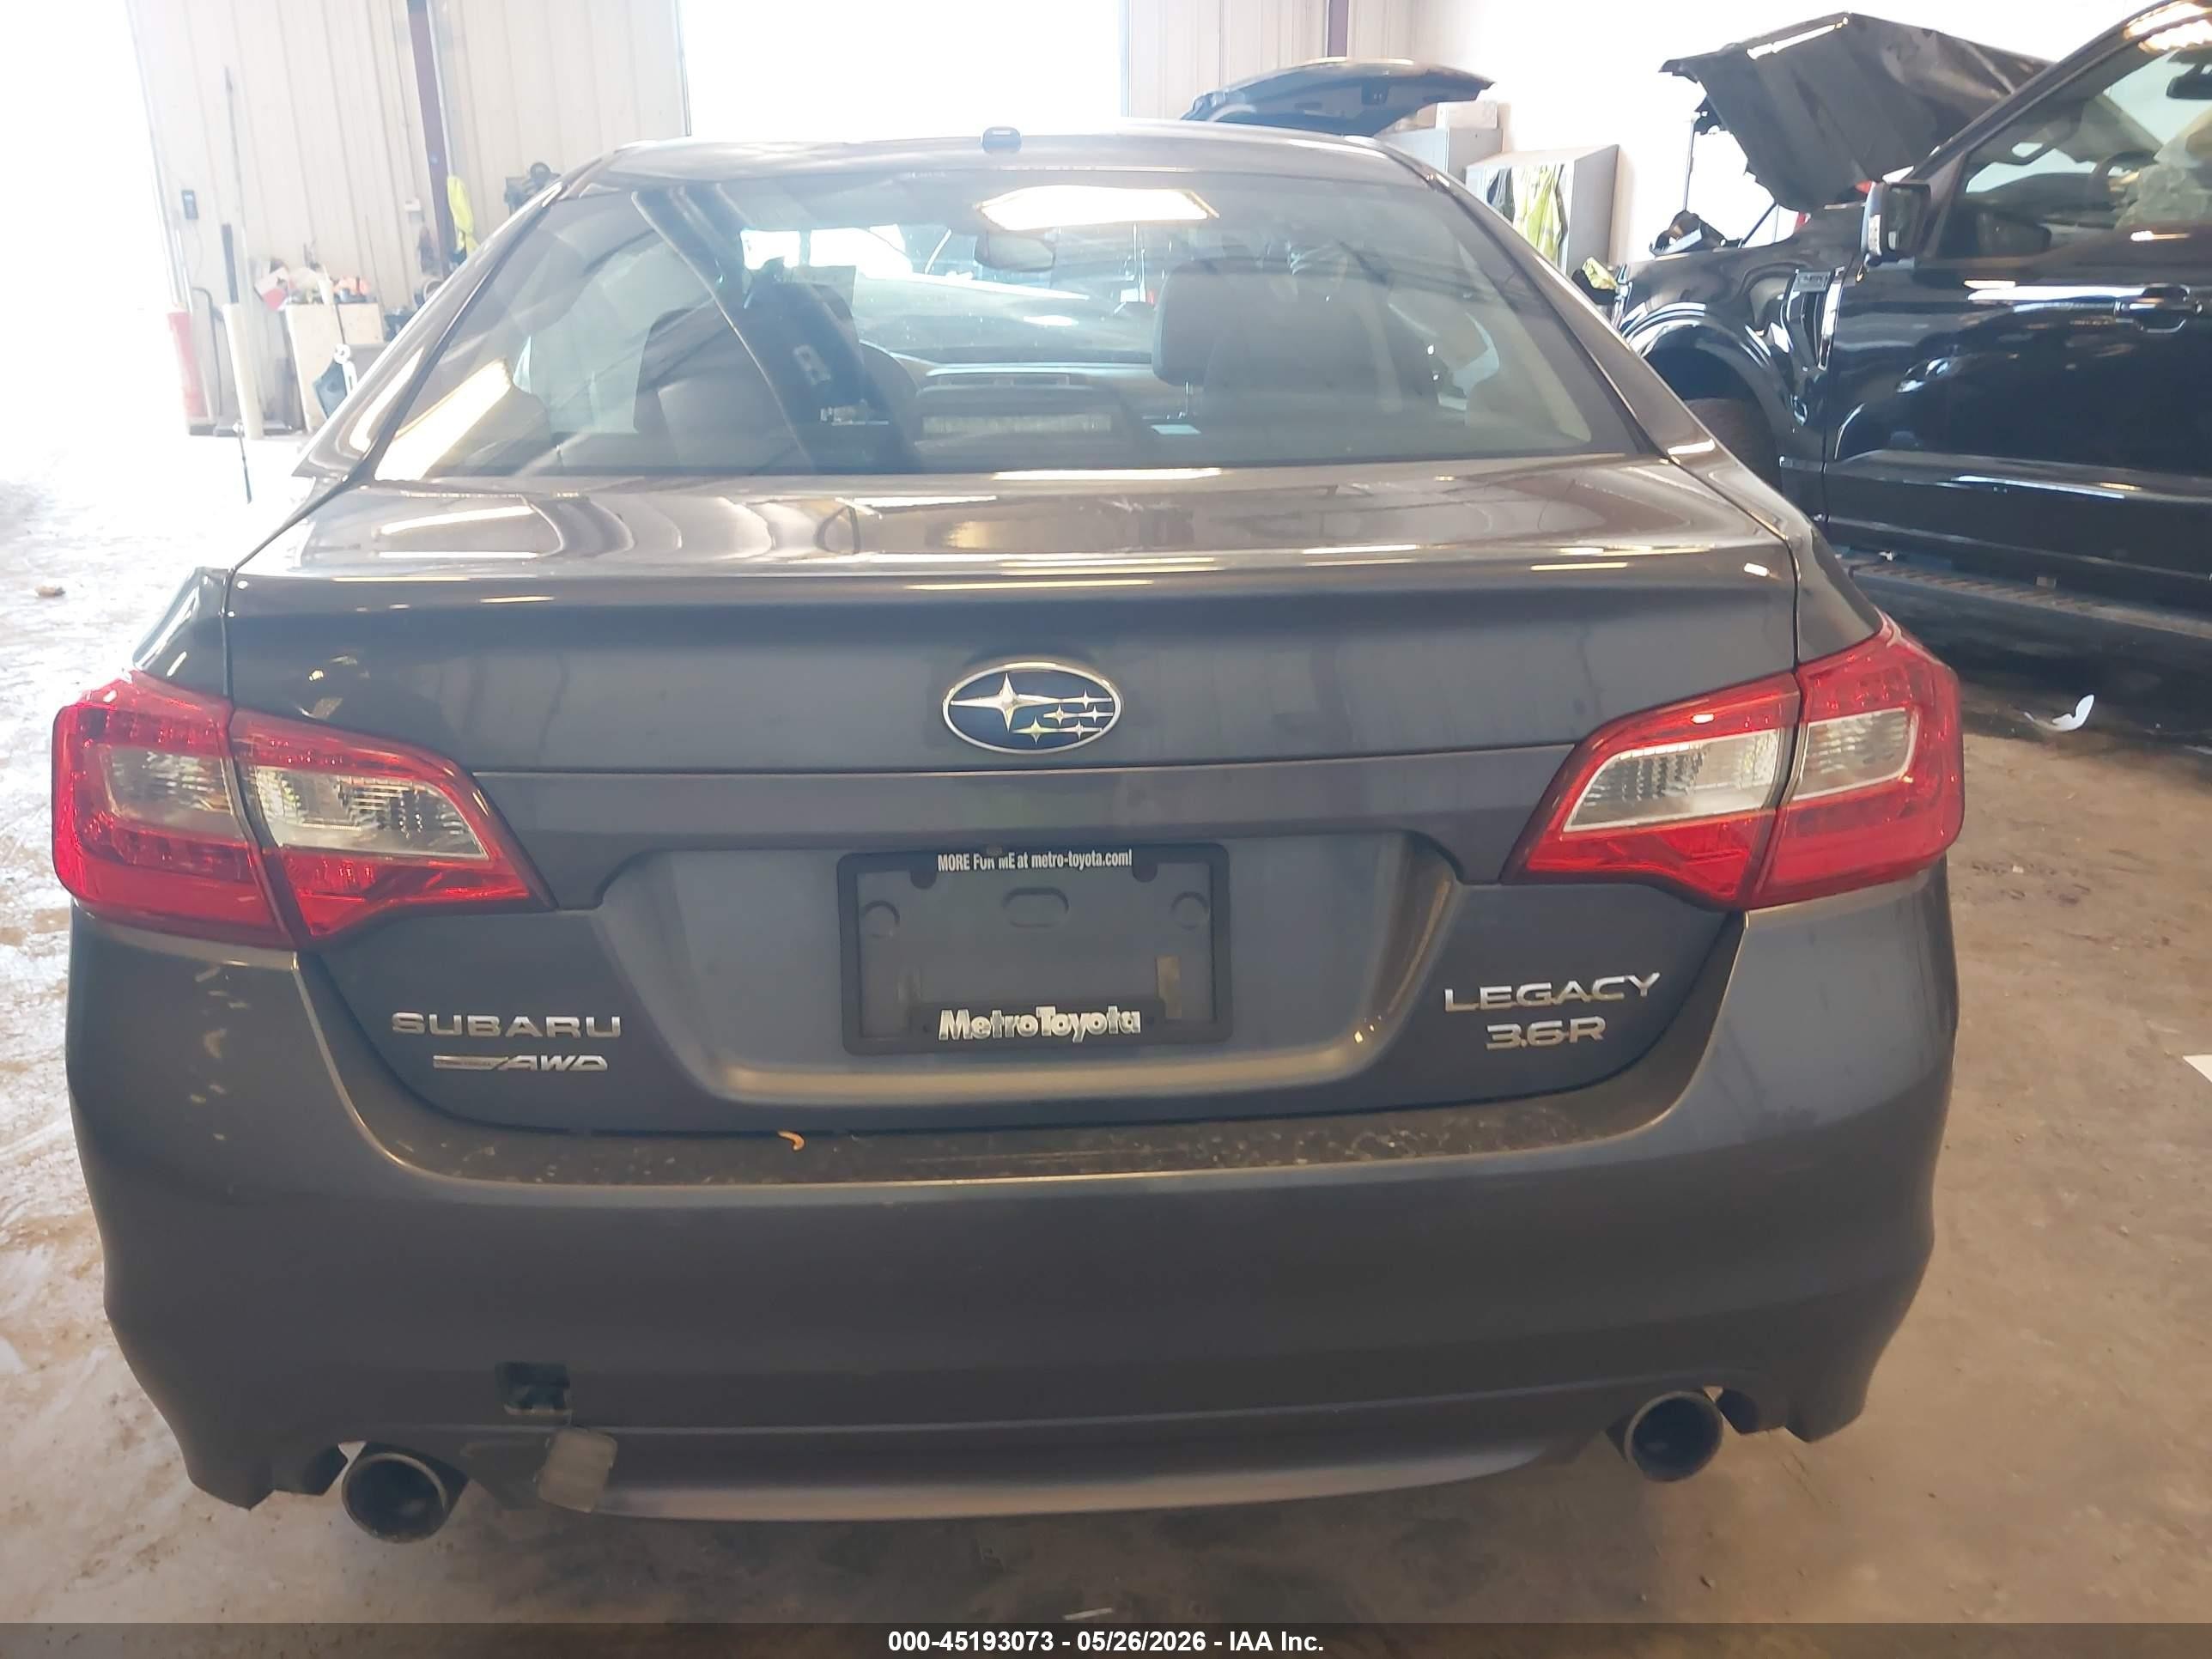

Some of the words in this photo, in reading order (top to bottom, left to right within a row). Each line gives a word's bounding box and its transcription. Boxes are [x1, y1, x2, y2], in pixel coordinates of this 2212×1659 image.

[938, 853, 970, 872] MORE
[1017, 851, 1029, 869] at
[1030, 849, 1133, 871] metro-toyota.com!
[1444, 971, 1661, 1012] LEGACY
[392, 1012, 622, 1037] SUBARU
[939, 1006, 1141, 1042] MetroToyota
[1486, 1016, 1606, 1049] 3.6R
[497, 1054, 609, 1071] AWD
